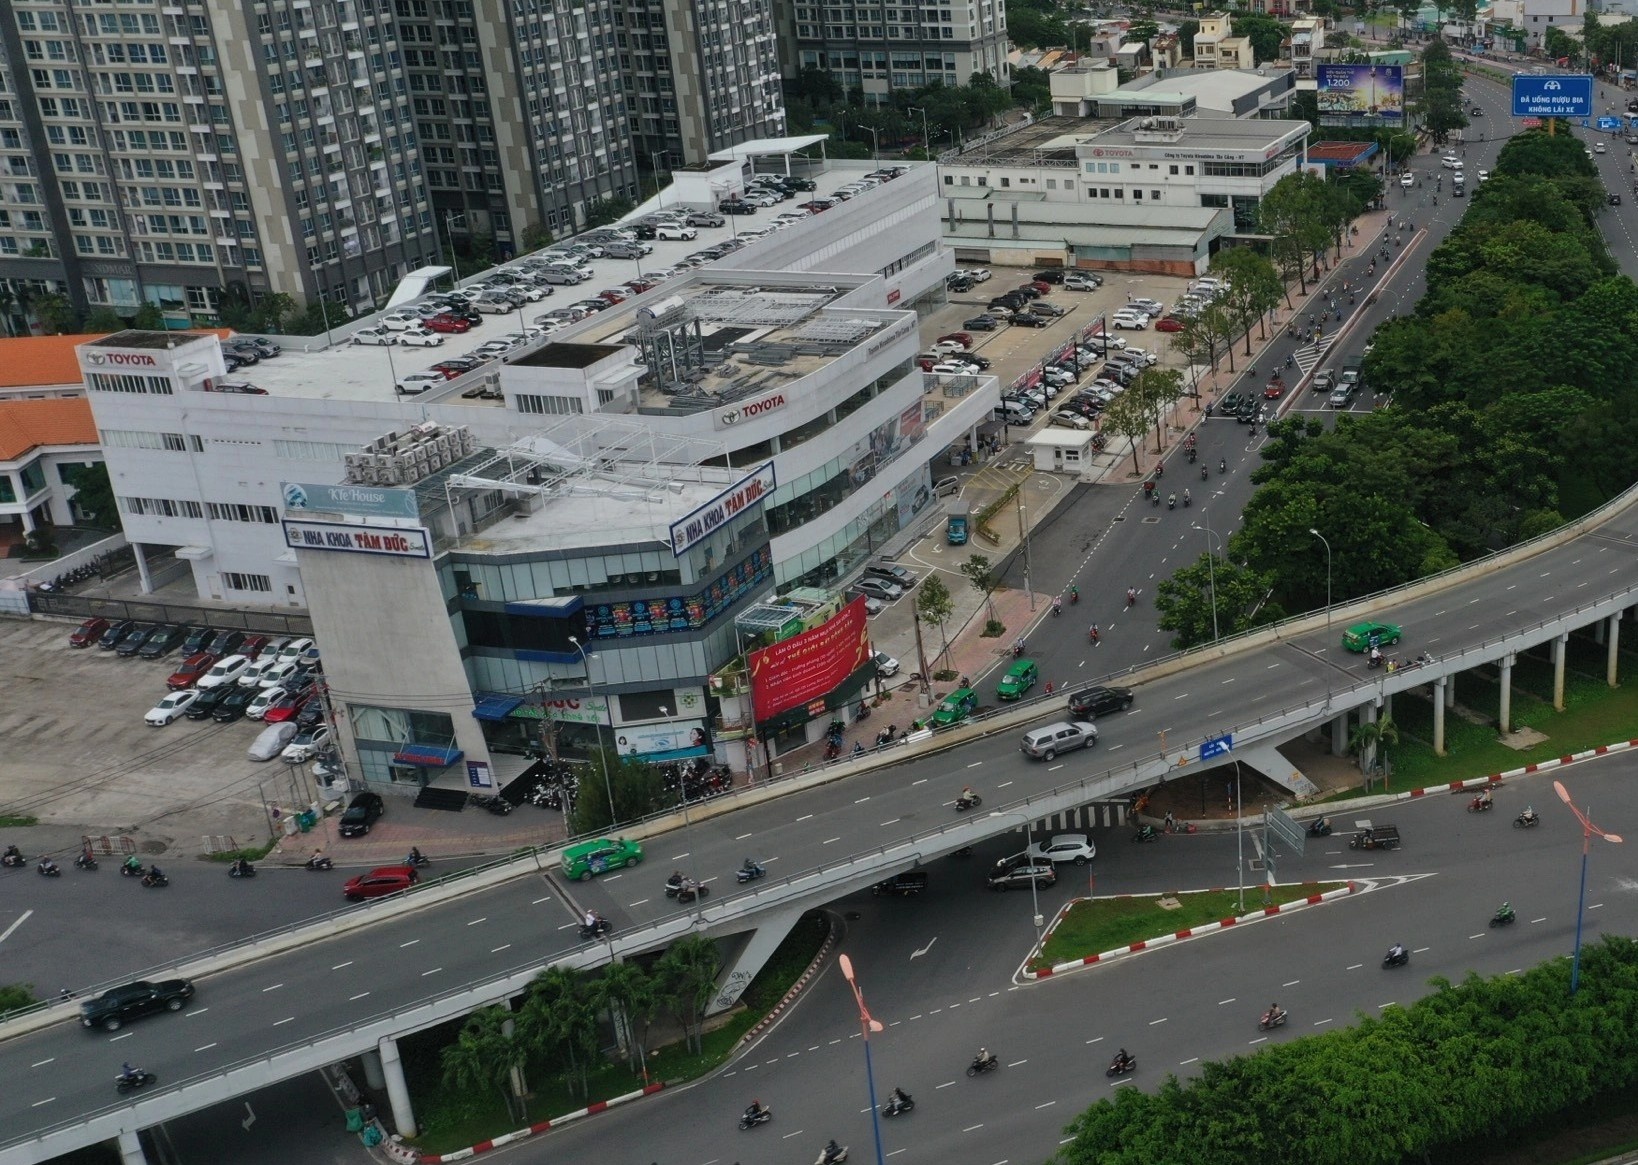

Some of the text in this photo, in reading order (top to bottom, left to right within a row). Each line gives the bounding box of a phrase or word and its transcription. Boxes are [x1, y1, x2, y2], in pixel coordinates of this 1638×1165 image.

[1327, 79, 1350, 87] 1.200
[1520, 95, 1530, 103] ĐÃ
[1531, 94, 1550, 103] UỐNG
[1551, 96, 1570, 105] RƯỢU
[1528, 105, 1552, 113] KHÔNG
[1553, 105, 1564, 113] LÁI
[1105, 149, 1134, 157] TOYOTA
[106, 353, 156, 366] TOYOTA
[742, 395, 785, 417] TOYOTA
[349, 488, 385, 503] House
[685, 519, 704, 543] NHA
[703, 505, 725, 532] KHOA
[725, 491, 745, 516] TÂM
[745, 479, 764, 504] ĐỨC
[303, 530, 325, 546] NHA
[325, 531, 353, 548] KHOA
[354, 531, 382, 550] TÂM
[382, 533, 409, 552] ĐỨC
